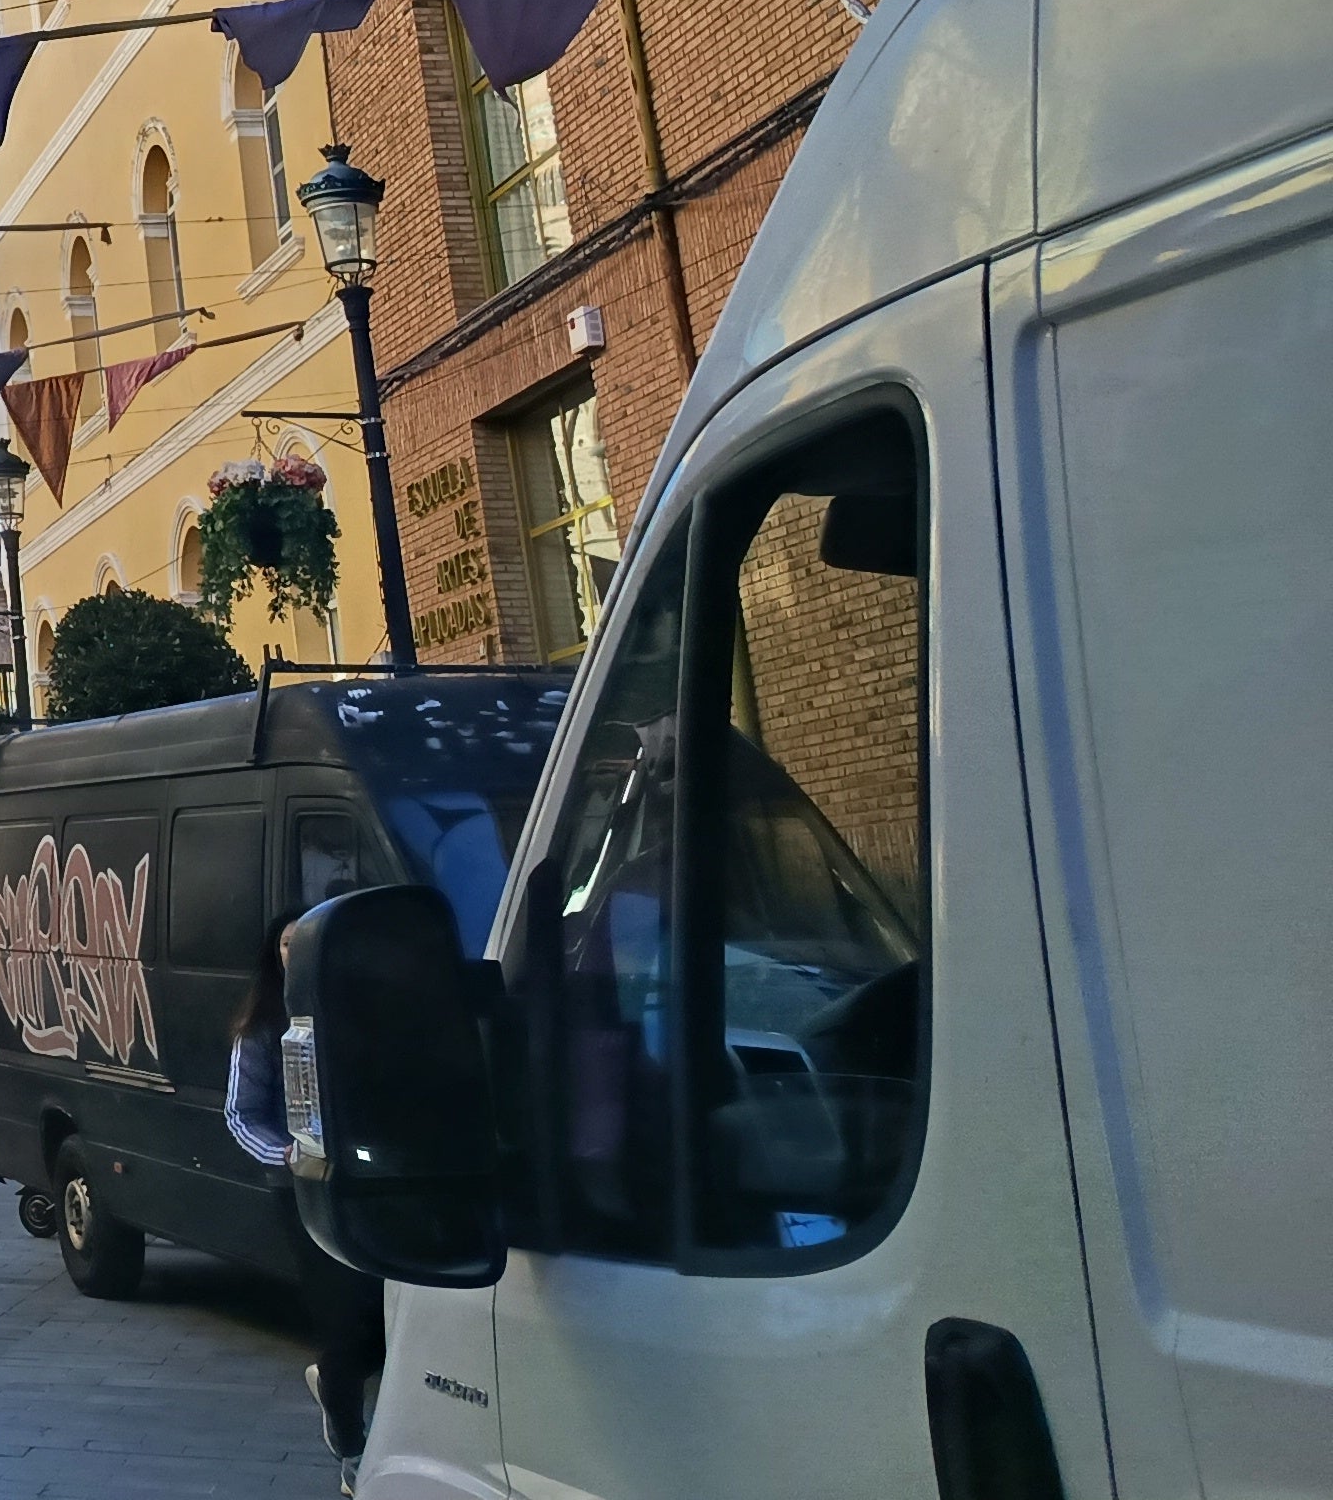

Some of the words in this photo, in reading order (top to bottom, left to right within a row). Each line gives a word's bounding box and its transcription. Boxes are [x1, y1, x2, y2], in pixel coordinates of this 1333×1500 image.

[406, 456, 475, 517] ESCUELA
[452, 499, 482, 541] DE
[434, 548, 488, 595] ARTES
[413, 592, 493, 648] APLICADAS
